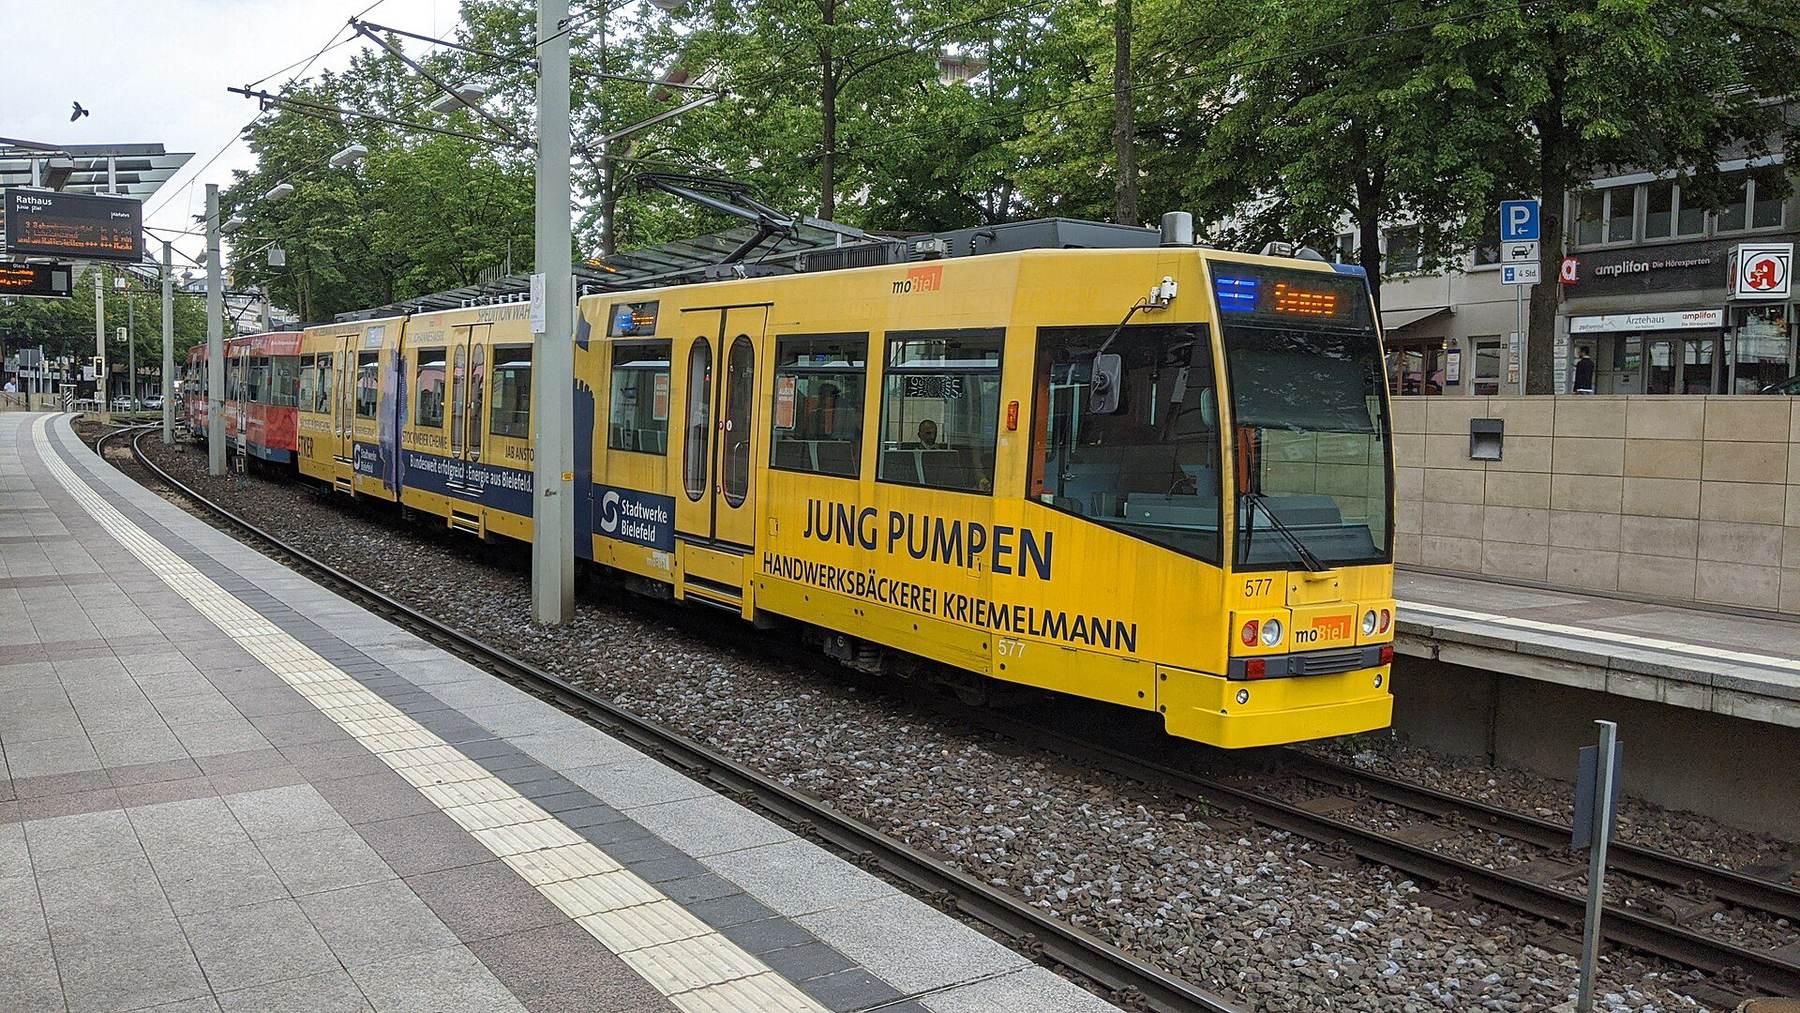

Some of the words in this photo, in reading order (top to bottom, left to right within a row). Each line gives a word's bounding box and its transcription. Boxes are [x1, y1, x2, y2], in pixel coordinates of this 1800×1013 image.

[16, 195, 52, 206] Rathaus
[1510, 205, 1530, 236] P
[1595, 260, 1650, 277] amplifon
[1652, 261, 1664, 269] Die
[1665, 257, 1710, 268] Hörexperten
[892, 272, 937, 294] moBiel
[1682, 310, 1717, 321] amplifon
[505, 445, 515, 460] JAB
[409, 454, 437, 473] Bundesweit
[490, 473, 501, 487] aus
[621, 499, 668, 524] Stadtwerke
[621, 520, 656, 542] Bielefeld
[803, 498, 879, 551] JUNG
[887, 510, 1054, 581] PUMPEN
[1245, 578, 1273, 598] 577
[762, 551, 938, 614] HANDWERKSBÄCKEREI
[943, 591, 1138, 653] KRIEMELMANN
[1295, 621, 1345, 644] moBiel
[997, 639, 1026, 658] 577
